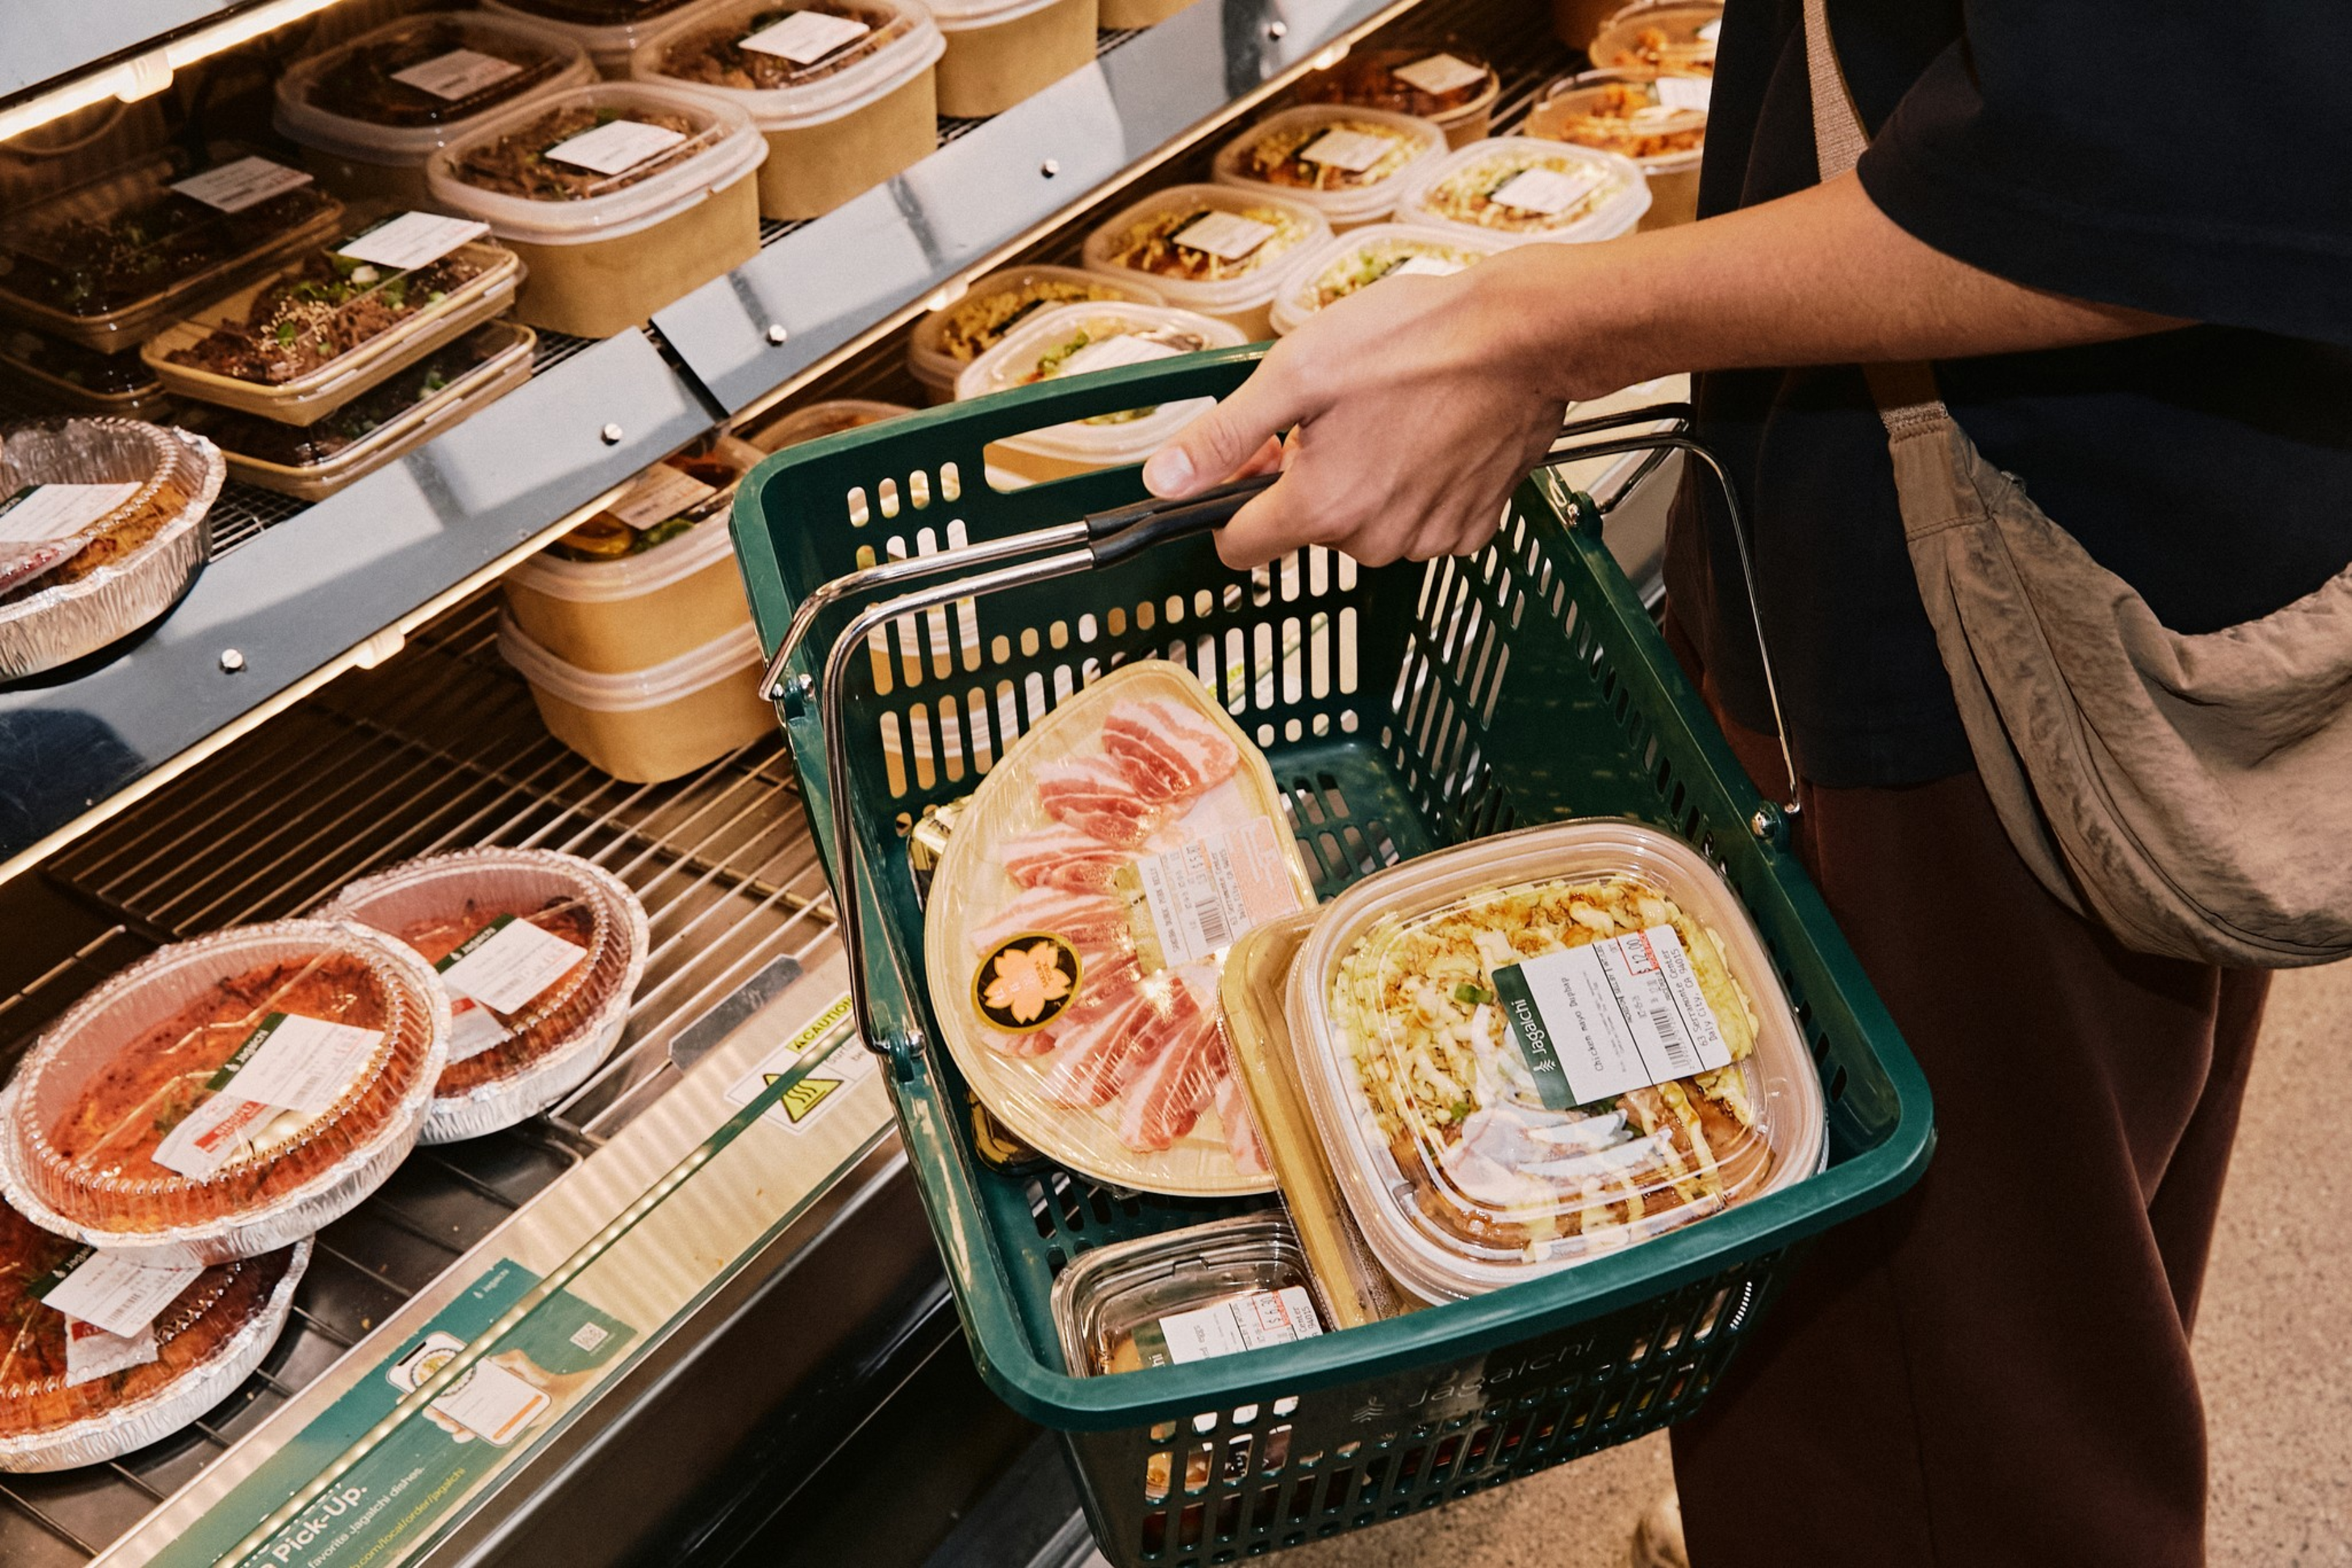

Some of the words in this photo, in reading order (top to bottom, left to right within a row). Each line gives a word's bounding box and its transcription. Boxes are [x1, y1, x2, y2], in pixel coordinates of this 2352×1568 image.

[1625, 937, 1649, 965] 12.00
[1661, 949, 1678, 979] Center
[1669, 948, 1687, 974] 94015
[1035, 960, 1048, 988] SAKURA
[1043, 962, 1053, 981] PORK
[1679, 976, 1693, 989] CA
[1560, 976, 1577, 1008] Dupbap
[1690, 992, 1706, 1018] City,
[802, 997, 850, 1039] CAUTION
[1574, 1009, 1588, 1031] mayo
[1676, 982, 1701, 1032] Serramonte
[1512, 999, 1547, 1054] Jagalchi
[1703, 1020, 1717, 1041] Daly
[1584, 1035, 1603, 1071] Chicken
[1696, 1035, 1708, 1047] 63
[1291, 1305, 1307, 1333] Center
[1301, 1305, 1317, 1329] 94015
[1407, 1338, 1595, 1408] Jagalchi
[272, 1487, 368, 1563] Pick-Up.
[308, 1533, 349, 1568] favorite
[349, 1496, 391, 1535] Jagalchi
[390, 1468, 425, 1498] dishes.
